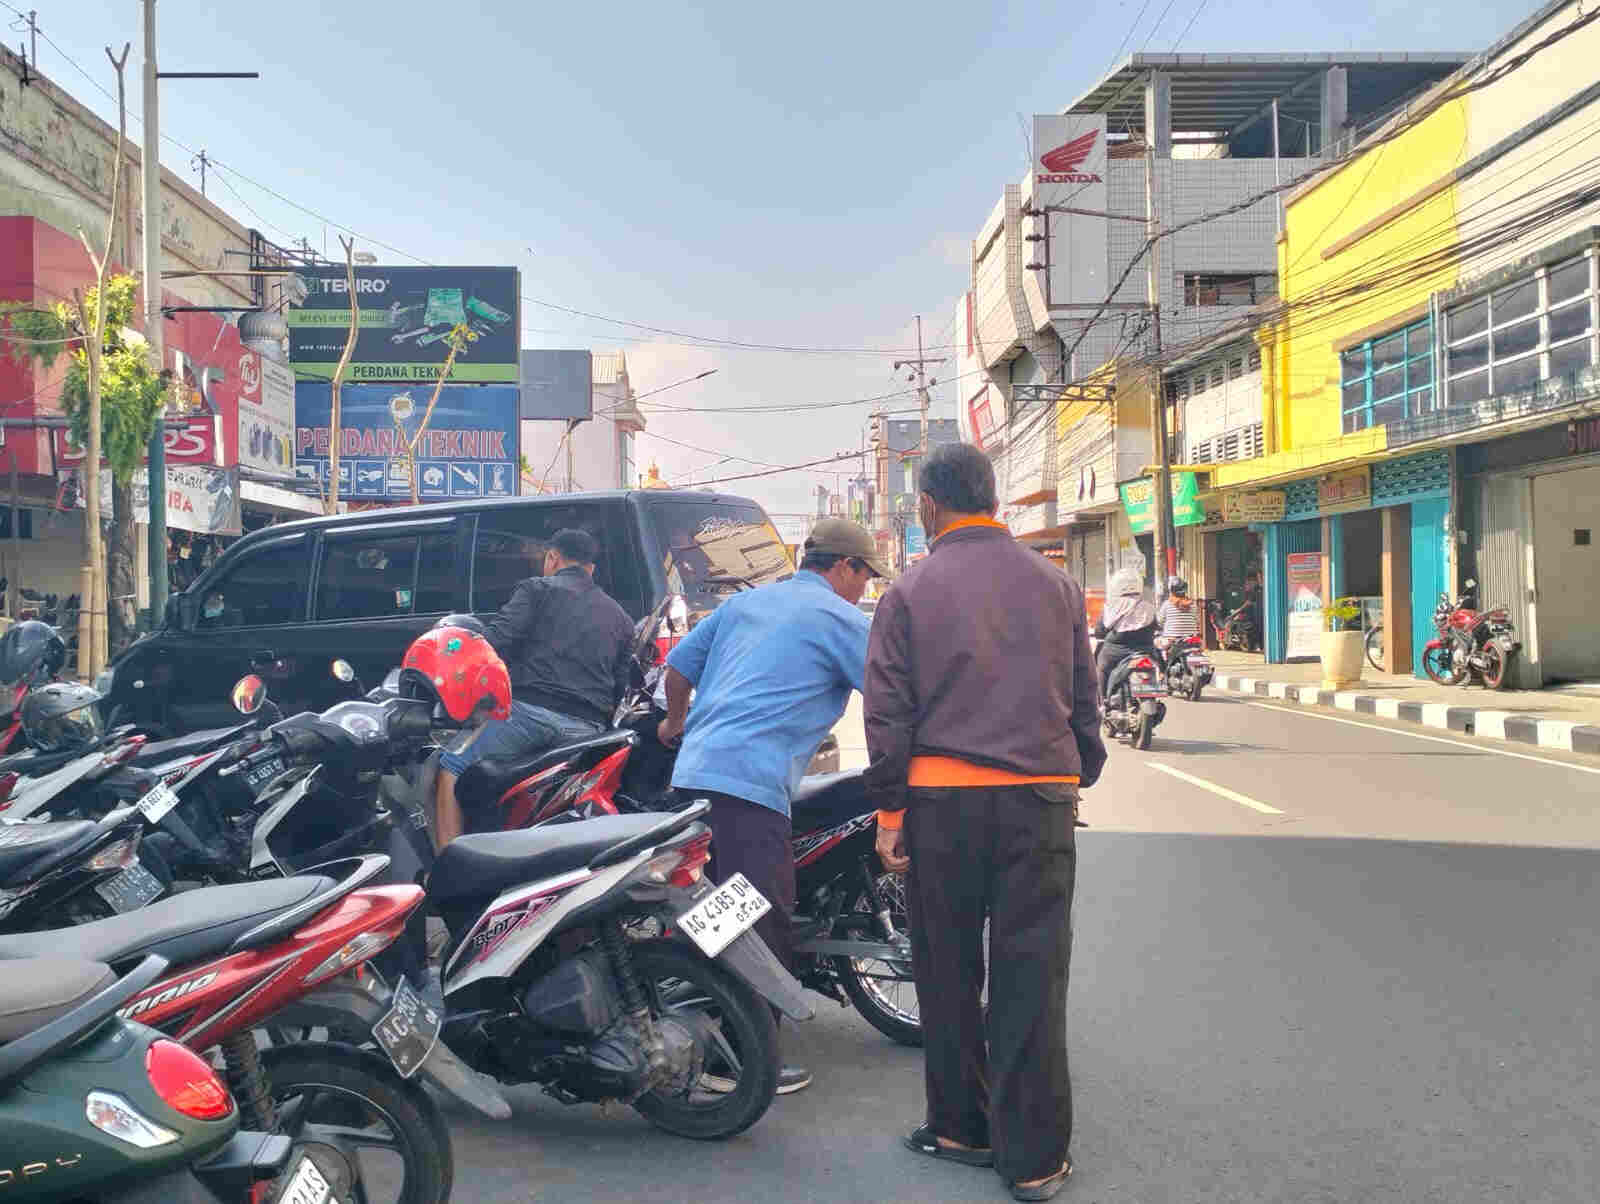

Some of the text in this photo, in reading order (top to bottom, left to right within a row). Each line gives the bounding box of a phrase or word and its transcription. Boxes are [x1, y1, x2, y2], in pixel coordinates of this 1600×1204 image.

[1037, 174, 1102, 185] HONDA
[353, 366, 455, 378] PERDANA TEKNK
[296, 426, 411, 457] PEDANA
[115, 970, 220, 1019] ARIO
